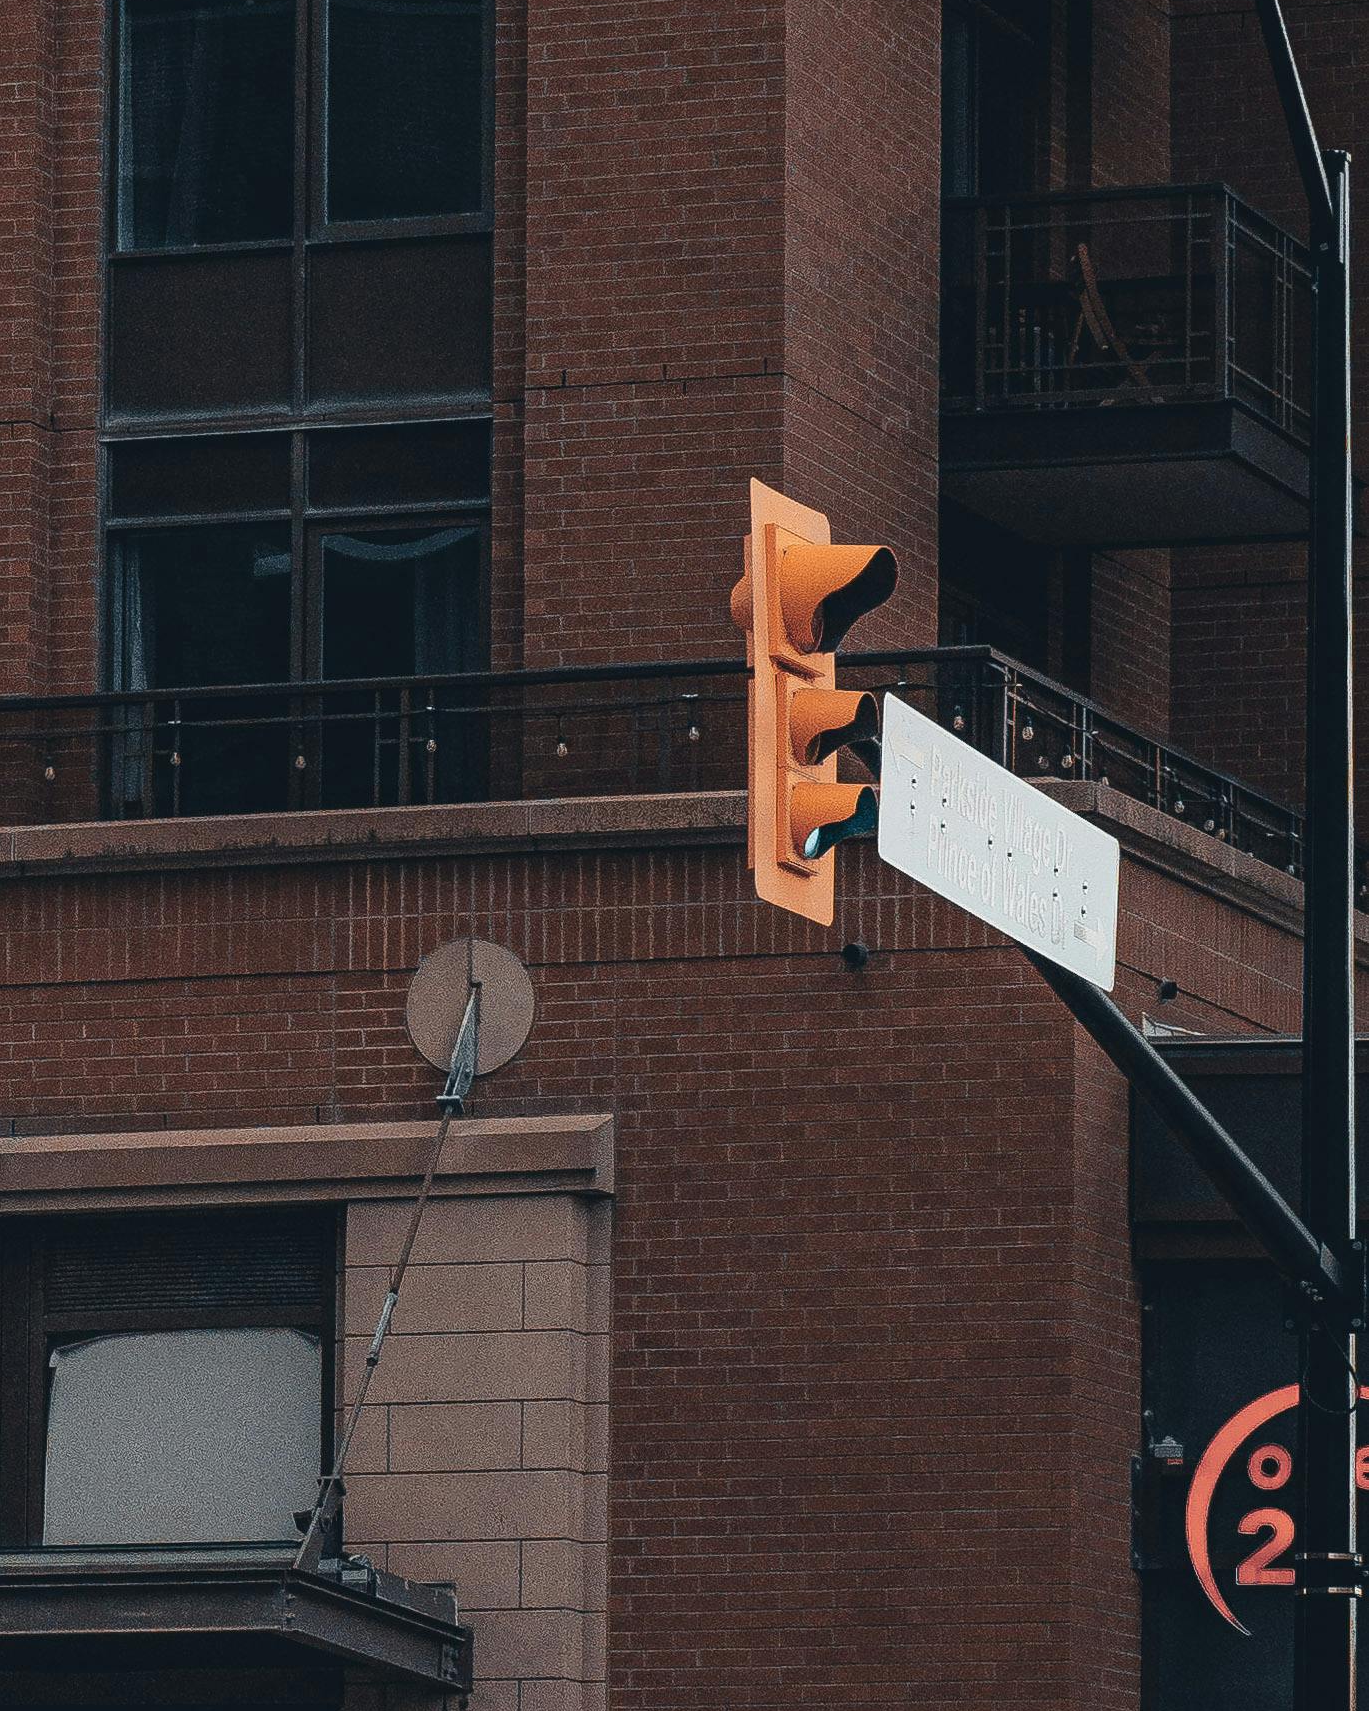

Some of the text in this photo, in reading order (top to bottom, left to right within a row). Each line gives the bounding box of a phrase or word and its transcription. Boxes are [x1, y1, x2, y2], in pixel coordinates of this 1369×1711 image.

[931, 744, 1072, 878] Parkside Village Dr
[928, 815, 1065, 950] Prince of Wales Dr
